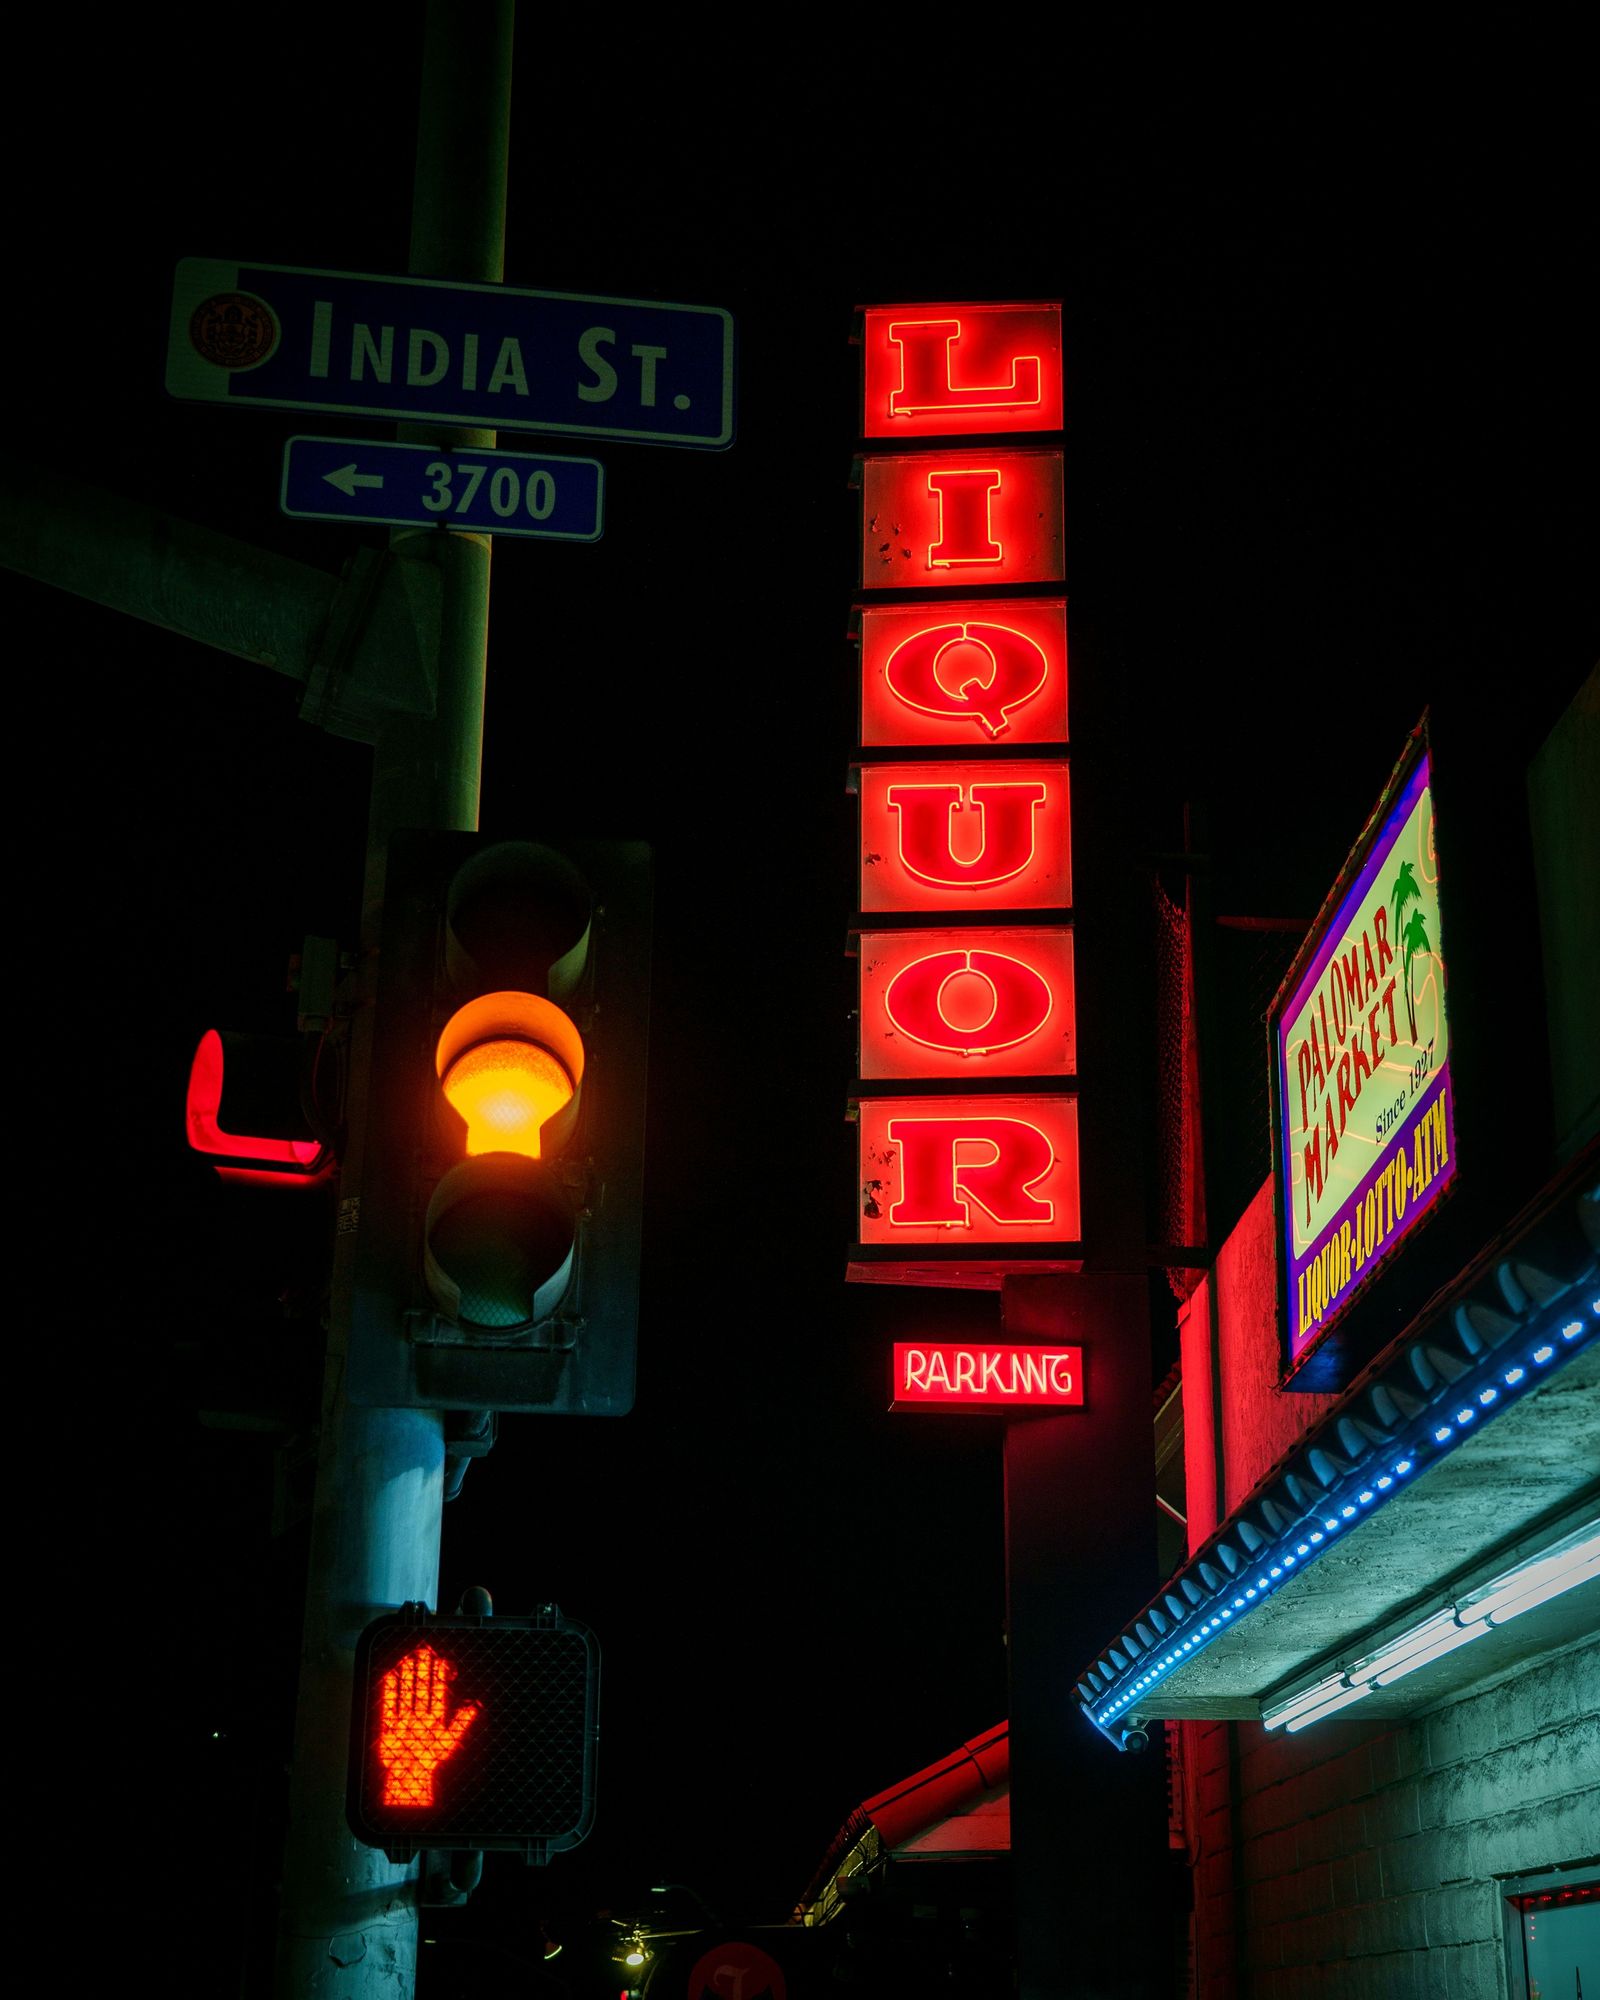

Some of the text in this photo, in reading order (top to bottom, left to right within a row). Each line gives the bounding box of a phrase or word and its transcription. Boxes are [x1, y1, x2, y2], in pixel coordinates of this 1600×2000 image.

[421, 461, 557, 520] 3700
[885, 319, 1055, 1228] LIQUOR
[1298, 905, 1393, 1133] PALOMAR
[1304, 976, 1398, 1229] MARKET
[1375, 1037, 1434, 1144] Since 1927
[904, 1349, 1073, 1395] PARKING
